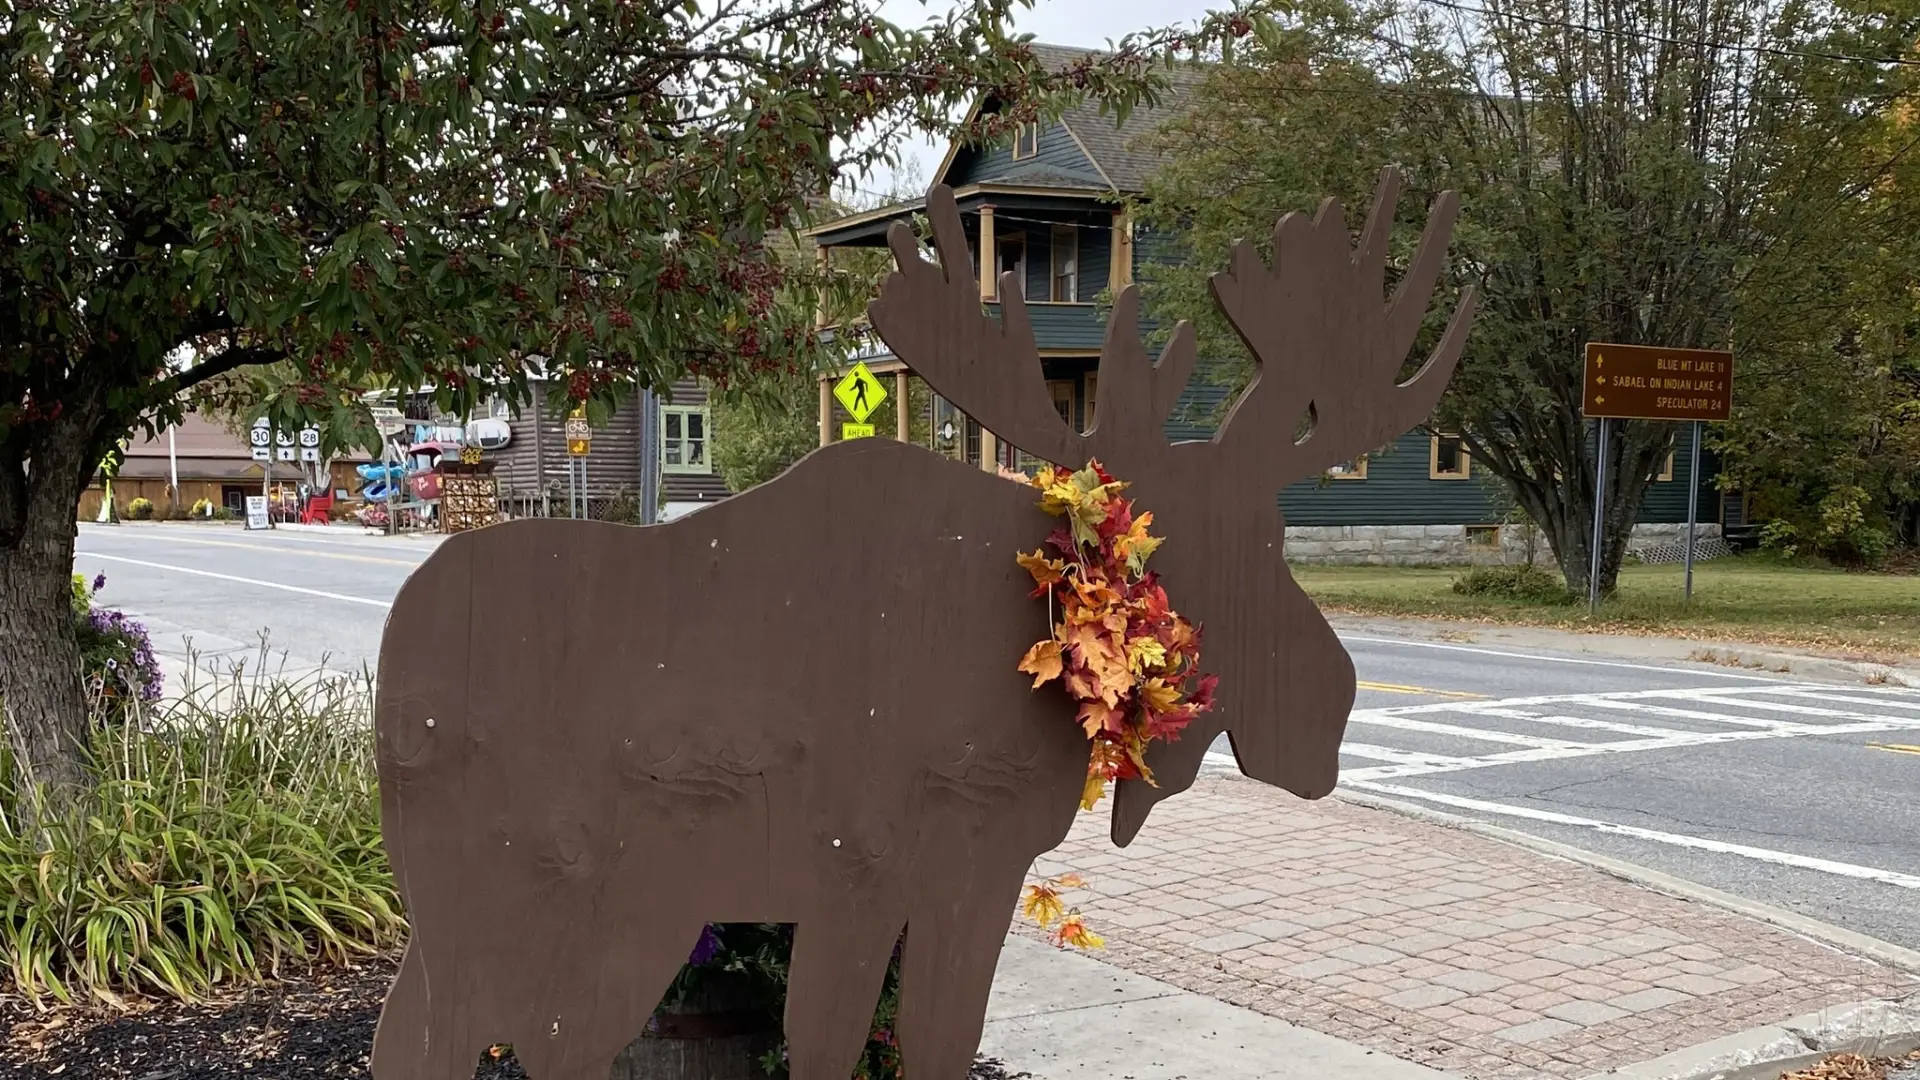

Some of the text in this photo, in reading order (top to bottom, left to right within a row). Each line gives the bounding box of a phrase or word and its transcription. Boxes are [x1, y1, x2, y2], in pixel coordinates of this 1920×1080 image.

[1657, 358, 1724, 373] BLUE MT LAKE 11
[1613, 375, 1723, 392] SABAEL ON INDIAN LAKE 4
[1656, 396, 1722, 410] SPECULATOR 24
[253, 431, 268, 442] 30
[303, 433, 316, 442] 28
[847, 428, 871, 438] AHEAD
